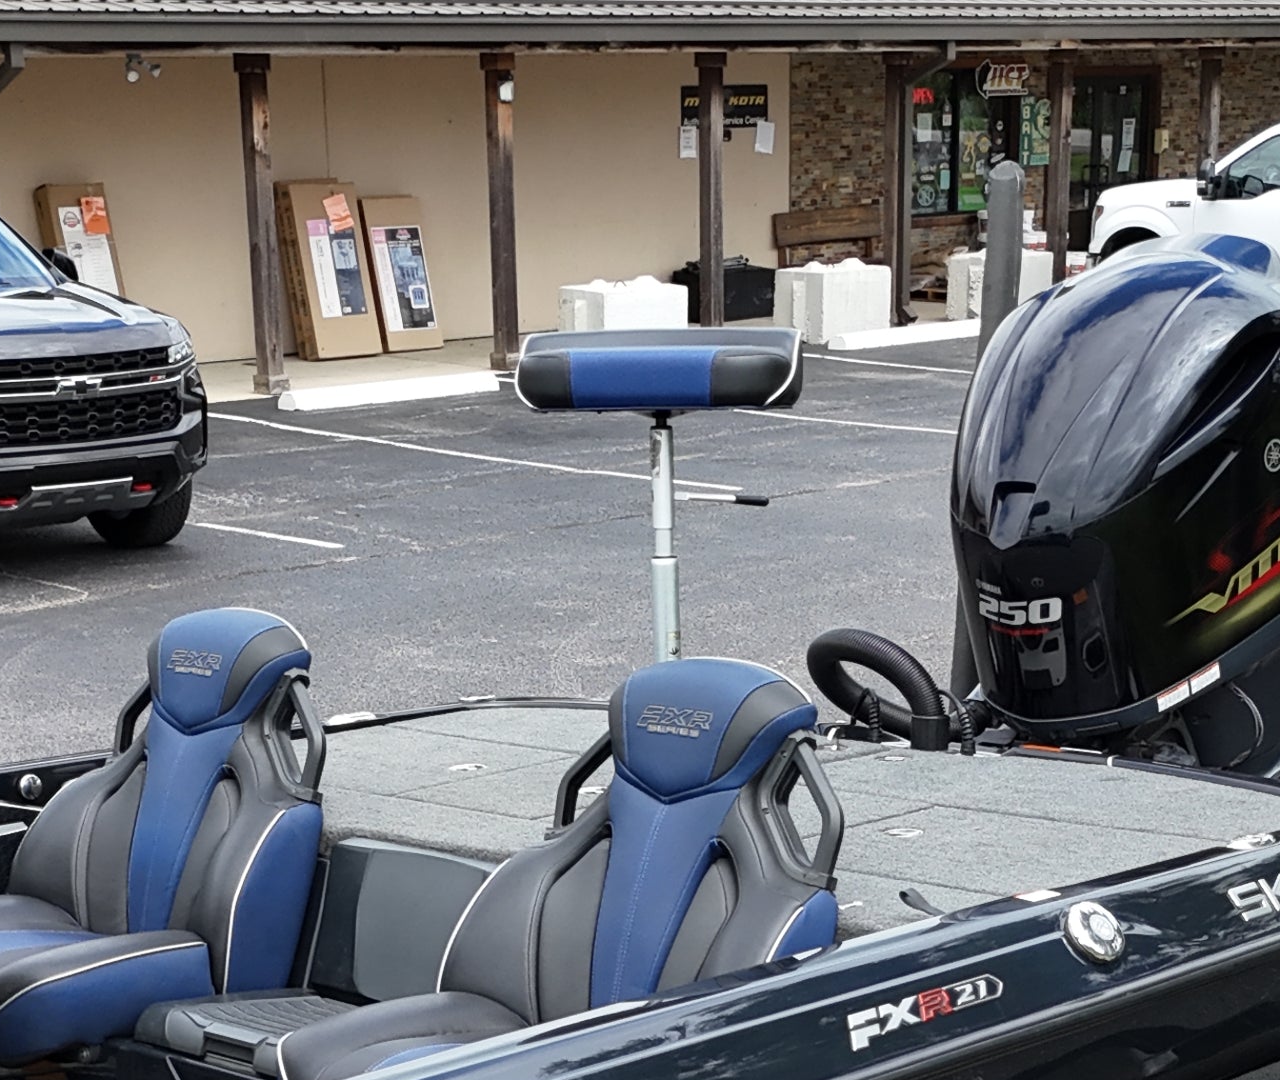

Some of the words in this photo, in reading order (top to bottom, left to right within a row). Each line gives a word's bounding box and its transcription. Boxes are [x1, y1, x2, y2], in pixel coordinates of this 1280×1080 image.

[729, 95, 766, 106] KOTA
[912, 87, 934, 104] PEN
[1022, 105, 1030, 165] BAIT
[979, 593, 1062, 626] 250
[166, 649, 223, 671] FXR
[636, 704, 714, 731] FXR
[846, 986, 955, 1053] FXR
[953, 979, 988, 1007] 21
